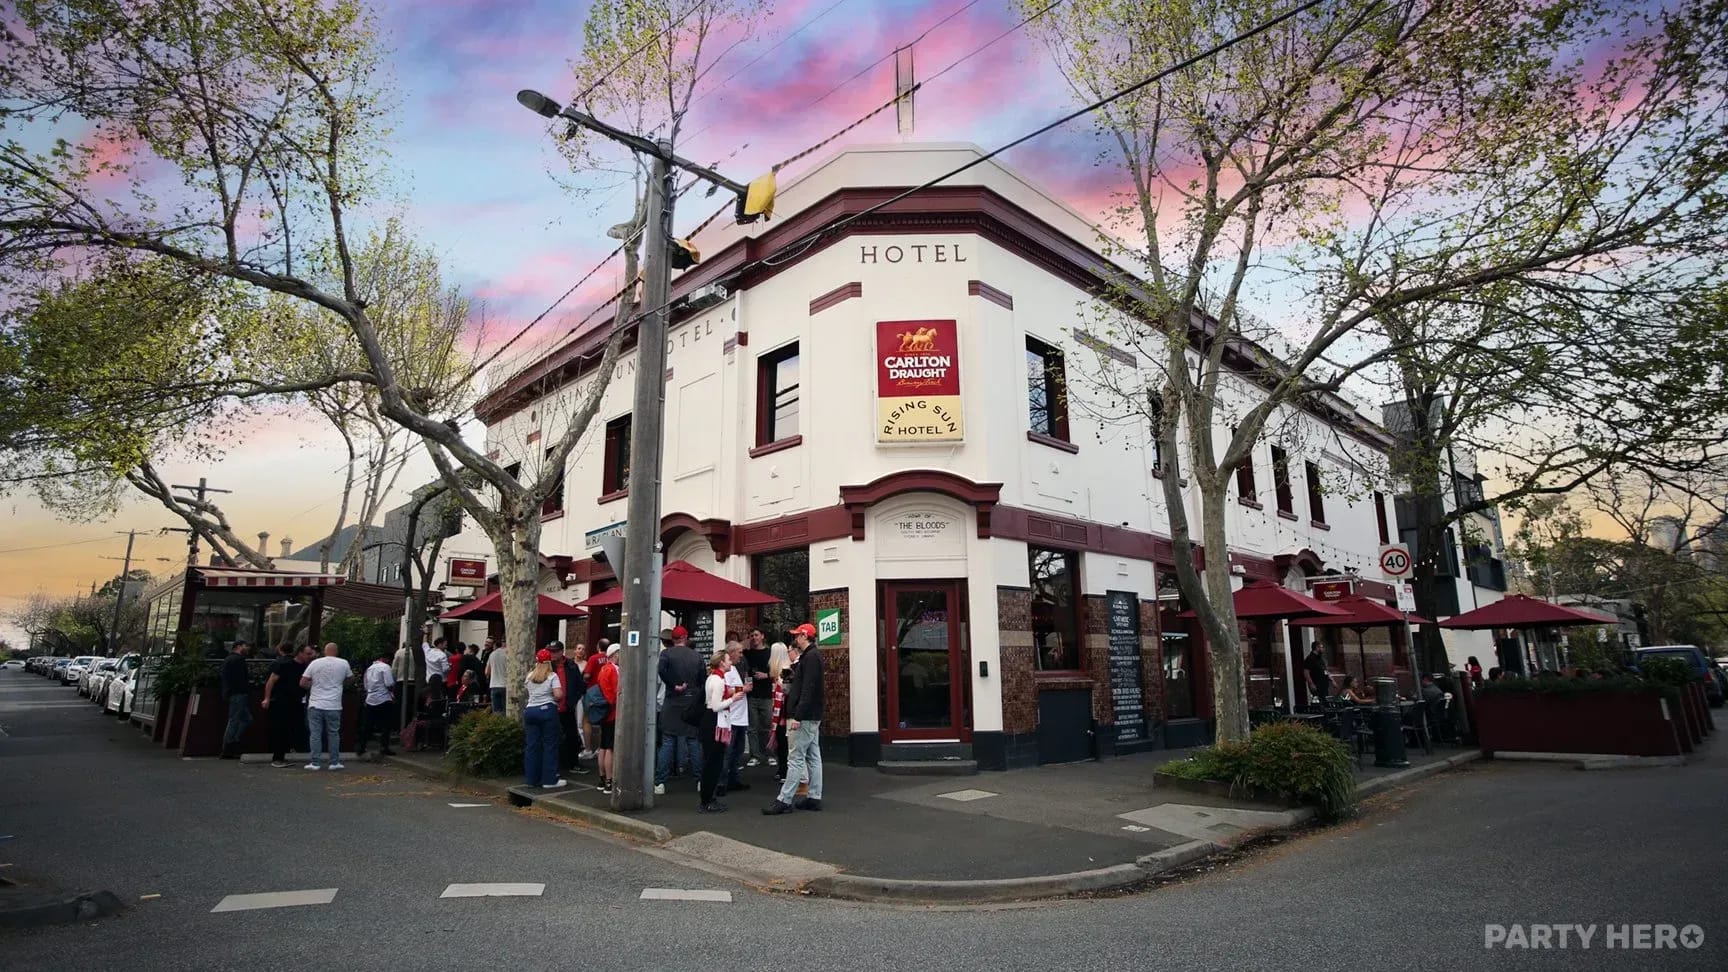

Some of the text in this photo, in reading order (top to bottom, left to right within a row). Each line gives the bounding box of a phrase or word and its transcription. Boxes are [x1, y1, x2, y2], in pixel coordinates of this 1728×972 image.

[861, 244, 967, 263] HOTEL
[666, 319, 713, 355] OTEL
[884, 355, 951, 369] CARLTON
[889, 368, 947, 379] DRAUGHT
[883, 400, 958, 435] RISING SUN
[898, 425, 943, 435] HOTEL
[1385, 554, 1406, 569] 40
[820, 621, 837, 633] TAB
